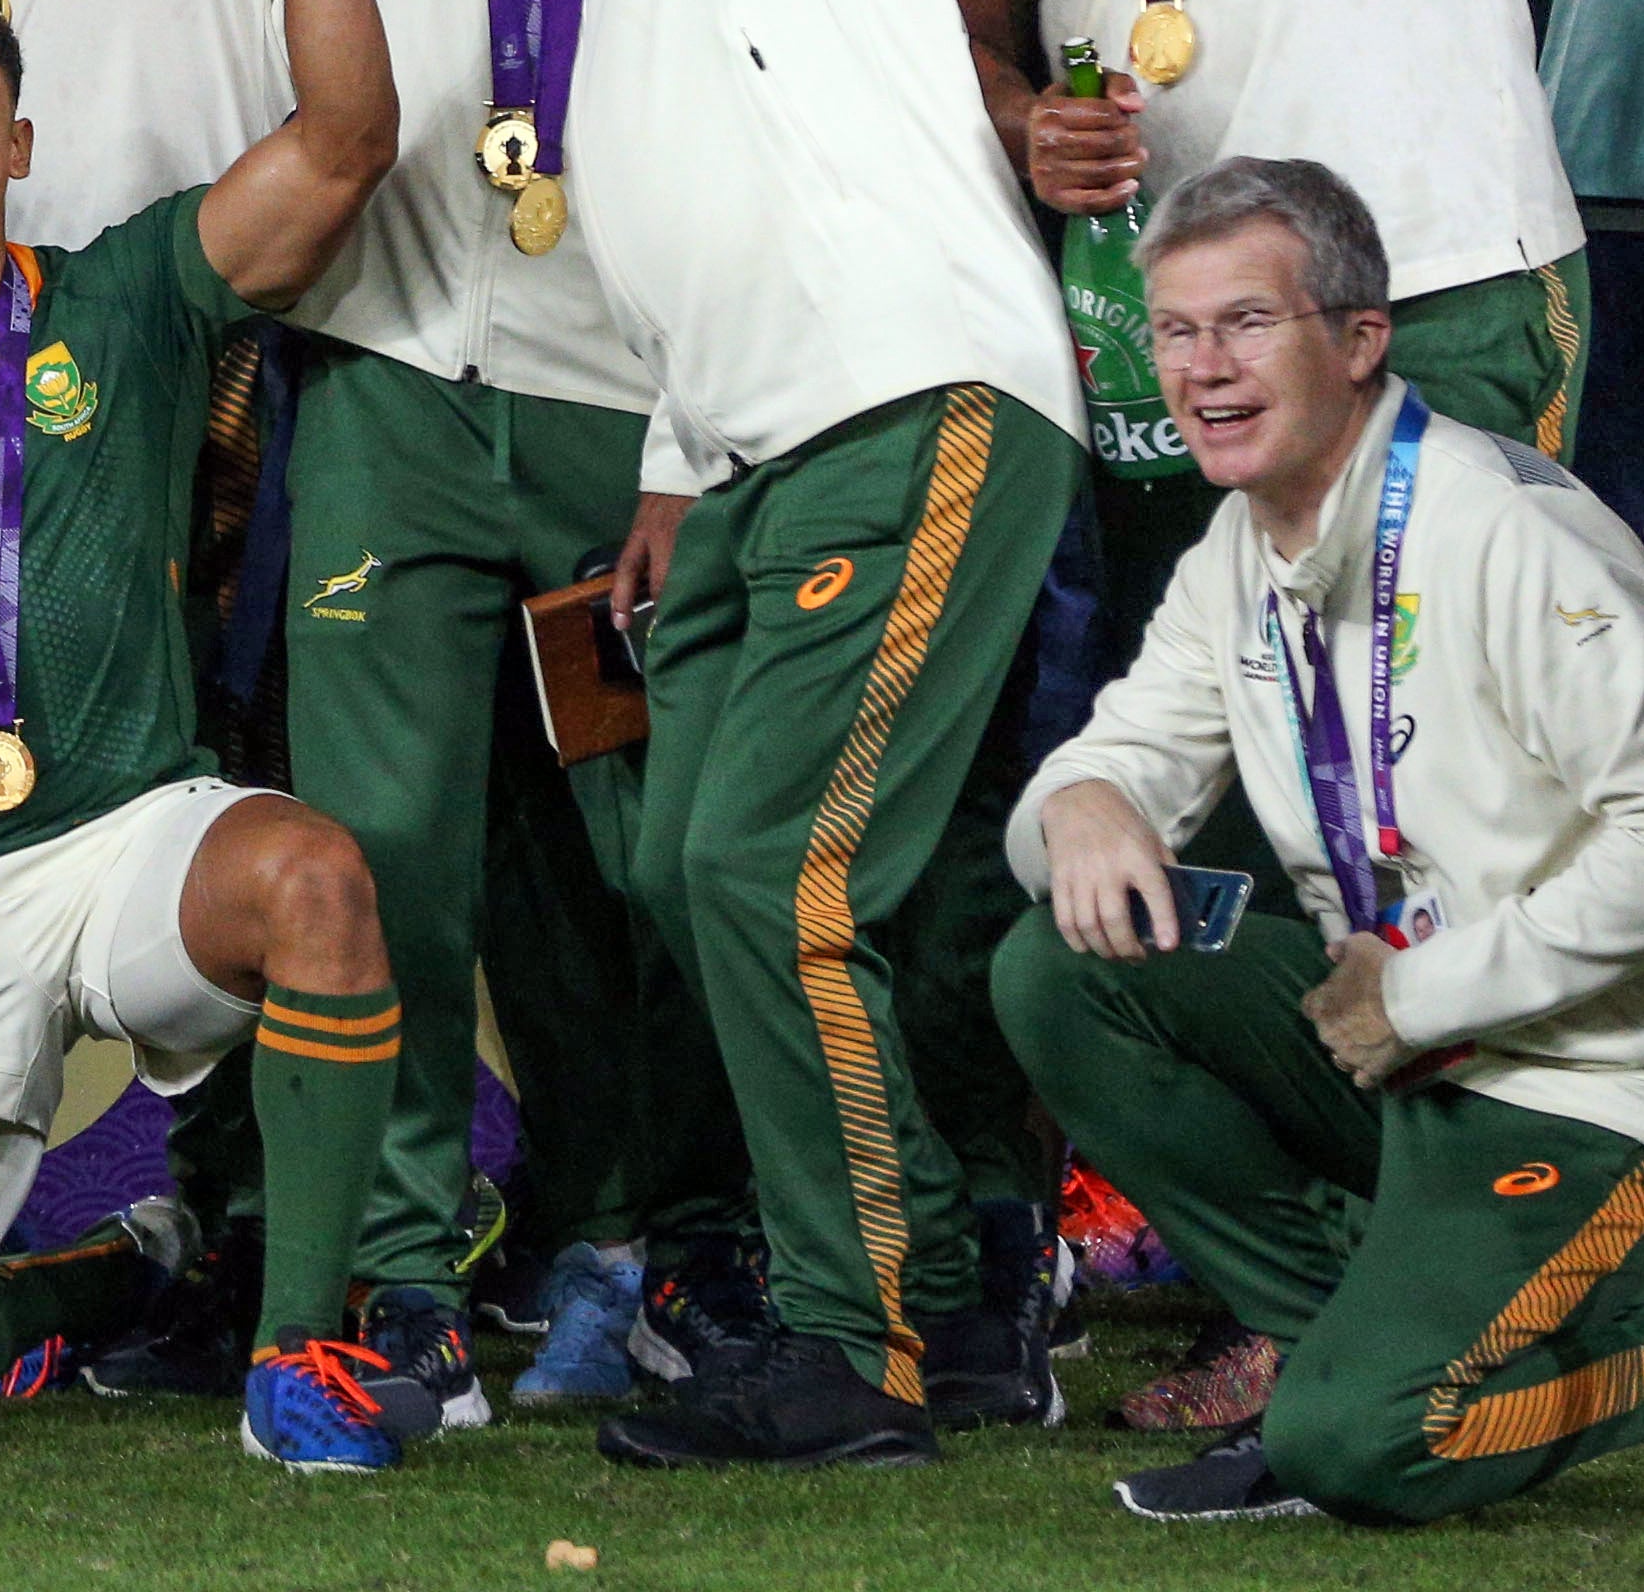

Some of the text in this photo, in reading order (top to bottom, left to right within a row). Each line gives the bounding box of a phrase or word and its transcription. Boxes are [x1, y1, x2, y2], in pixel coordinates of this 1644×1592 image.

[63, 421, 92, 443] RUGBY
[1372, 480, 1407, 720] THE WORLD IN UNION
[312, 606, 366, 622] SPRINGBOK
